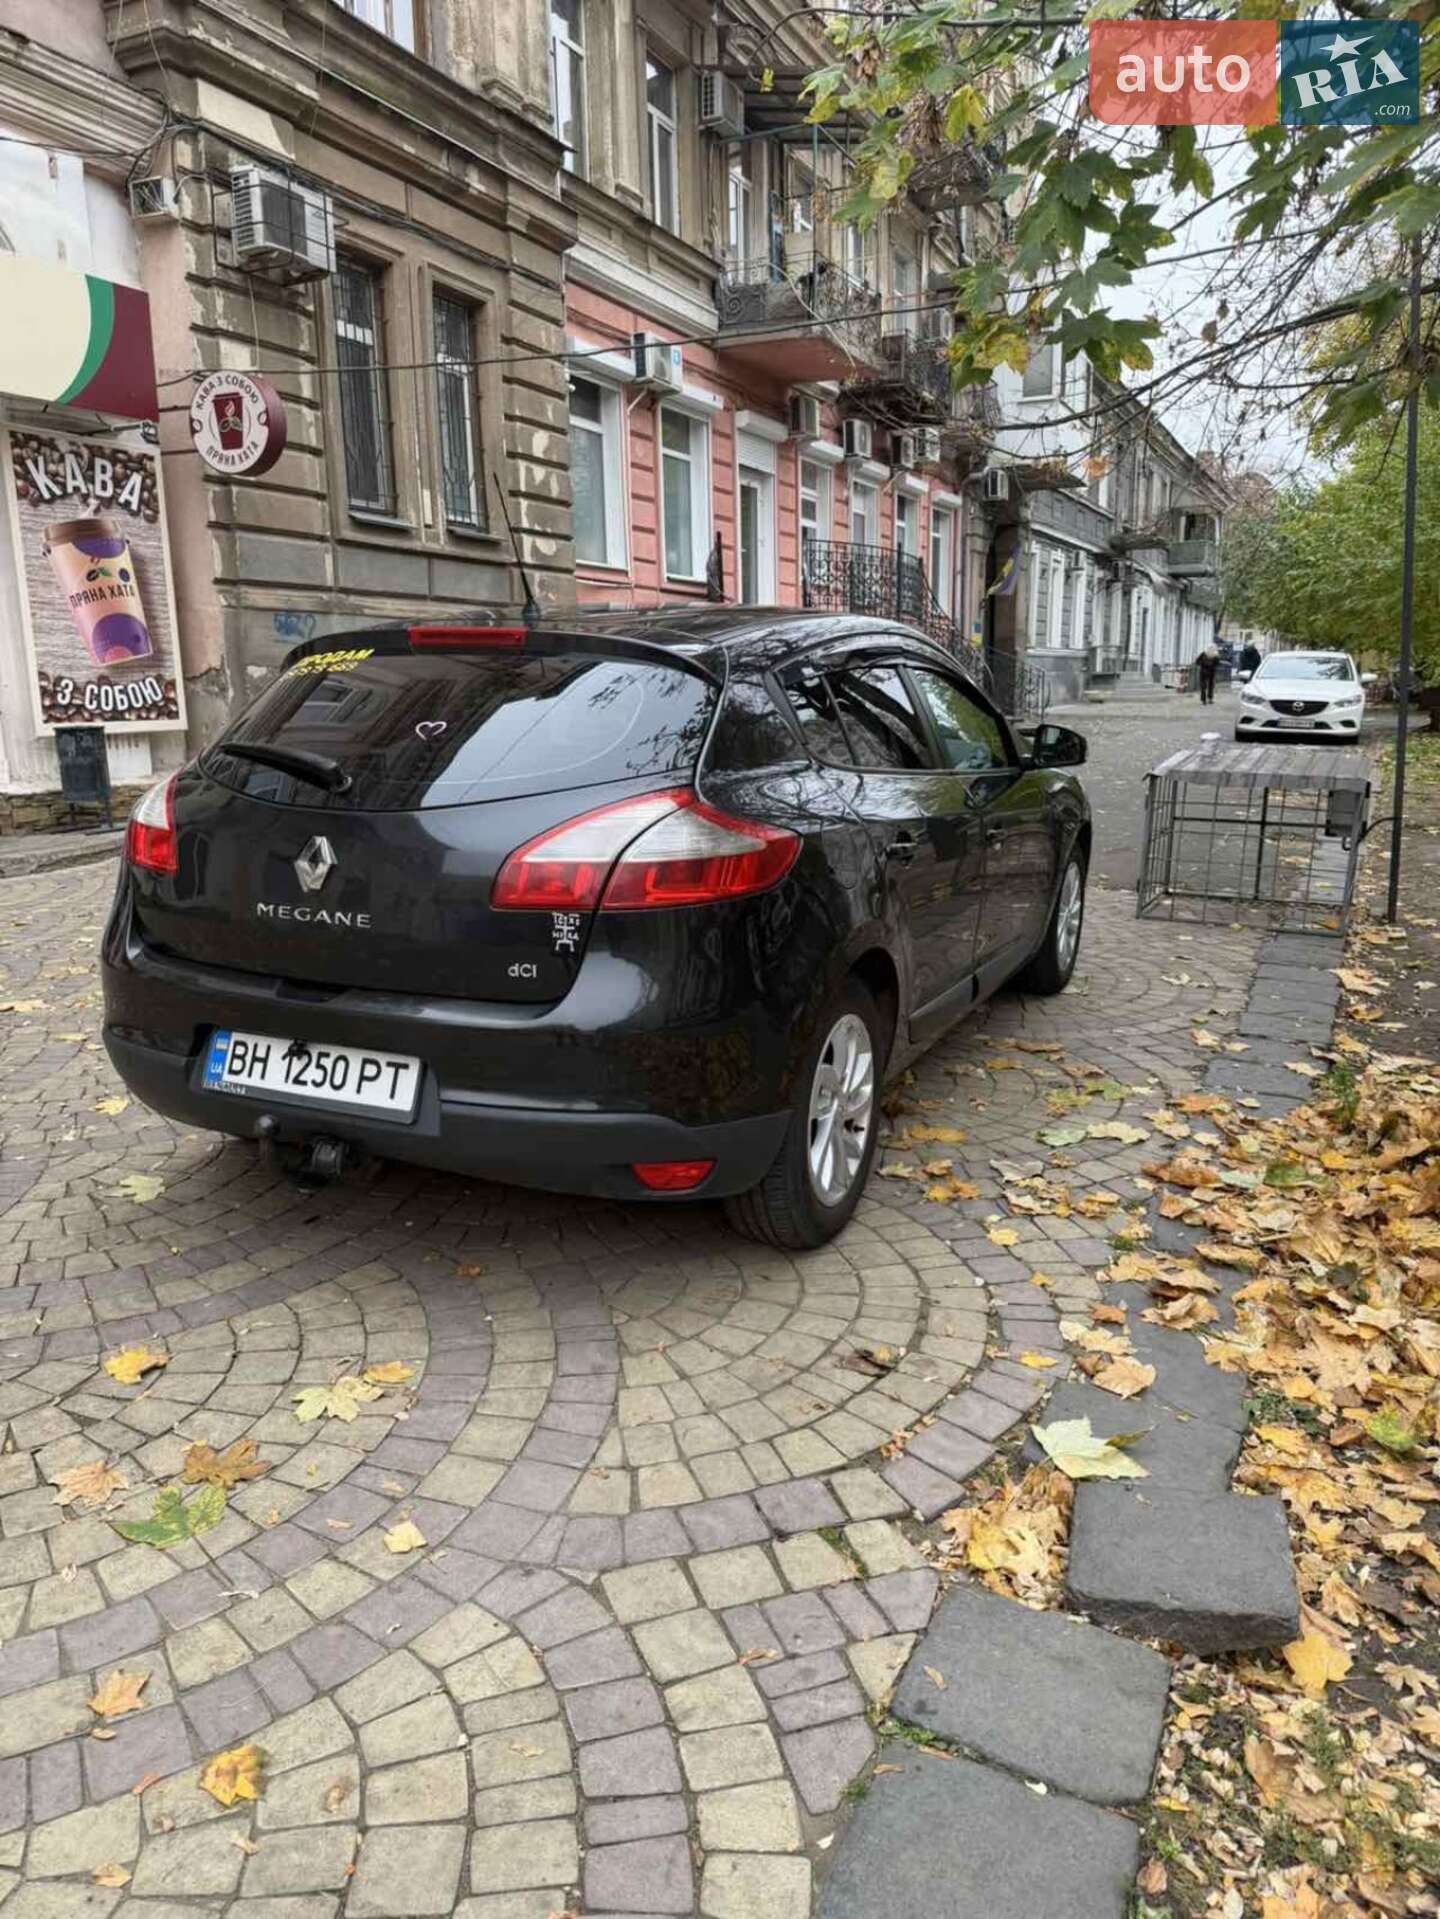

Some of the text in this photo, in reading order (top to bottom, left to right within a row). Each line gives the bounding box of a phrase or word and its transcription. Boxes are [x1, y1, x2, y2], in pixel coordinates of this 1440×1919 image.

[196, 382, 216, 410] КАВА
[225, 375, 259, 404] СОБОЮ
[25, 453, 143, 511] КАВА
[69, 587, 107, 608] ПРЯНА
[56, 676, 164, 711] З СОБОЮ
[256, 902, 372, 929] MEGANE
[227, 1040, 271, 1081] BH
[281, 1049, 351, 1091] 1250
[356, 1057, 410, 1100] PT
